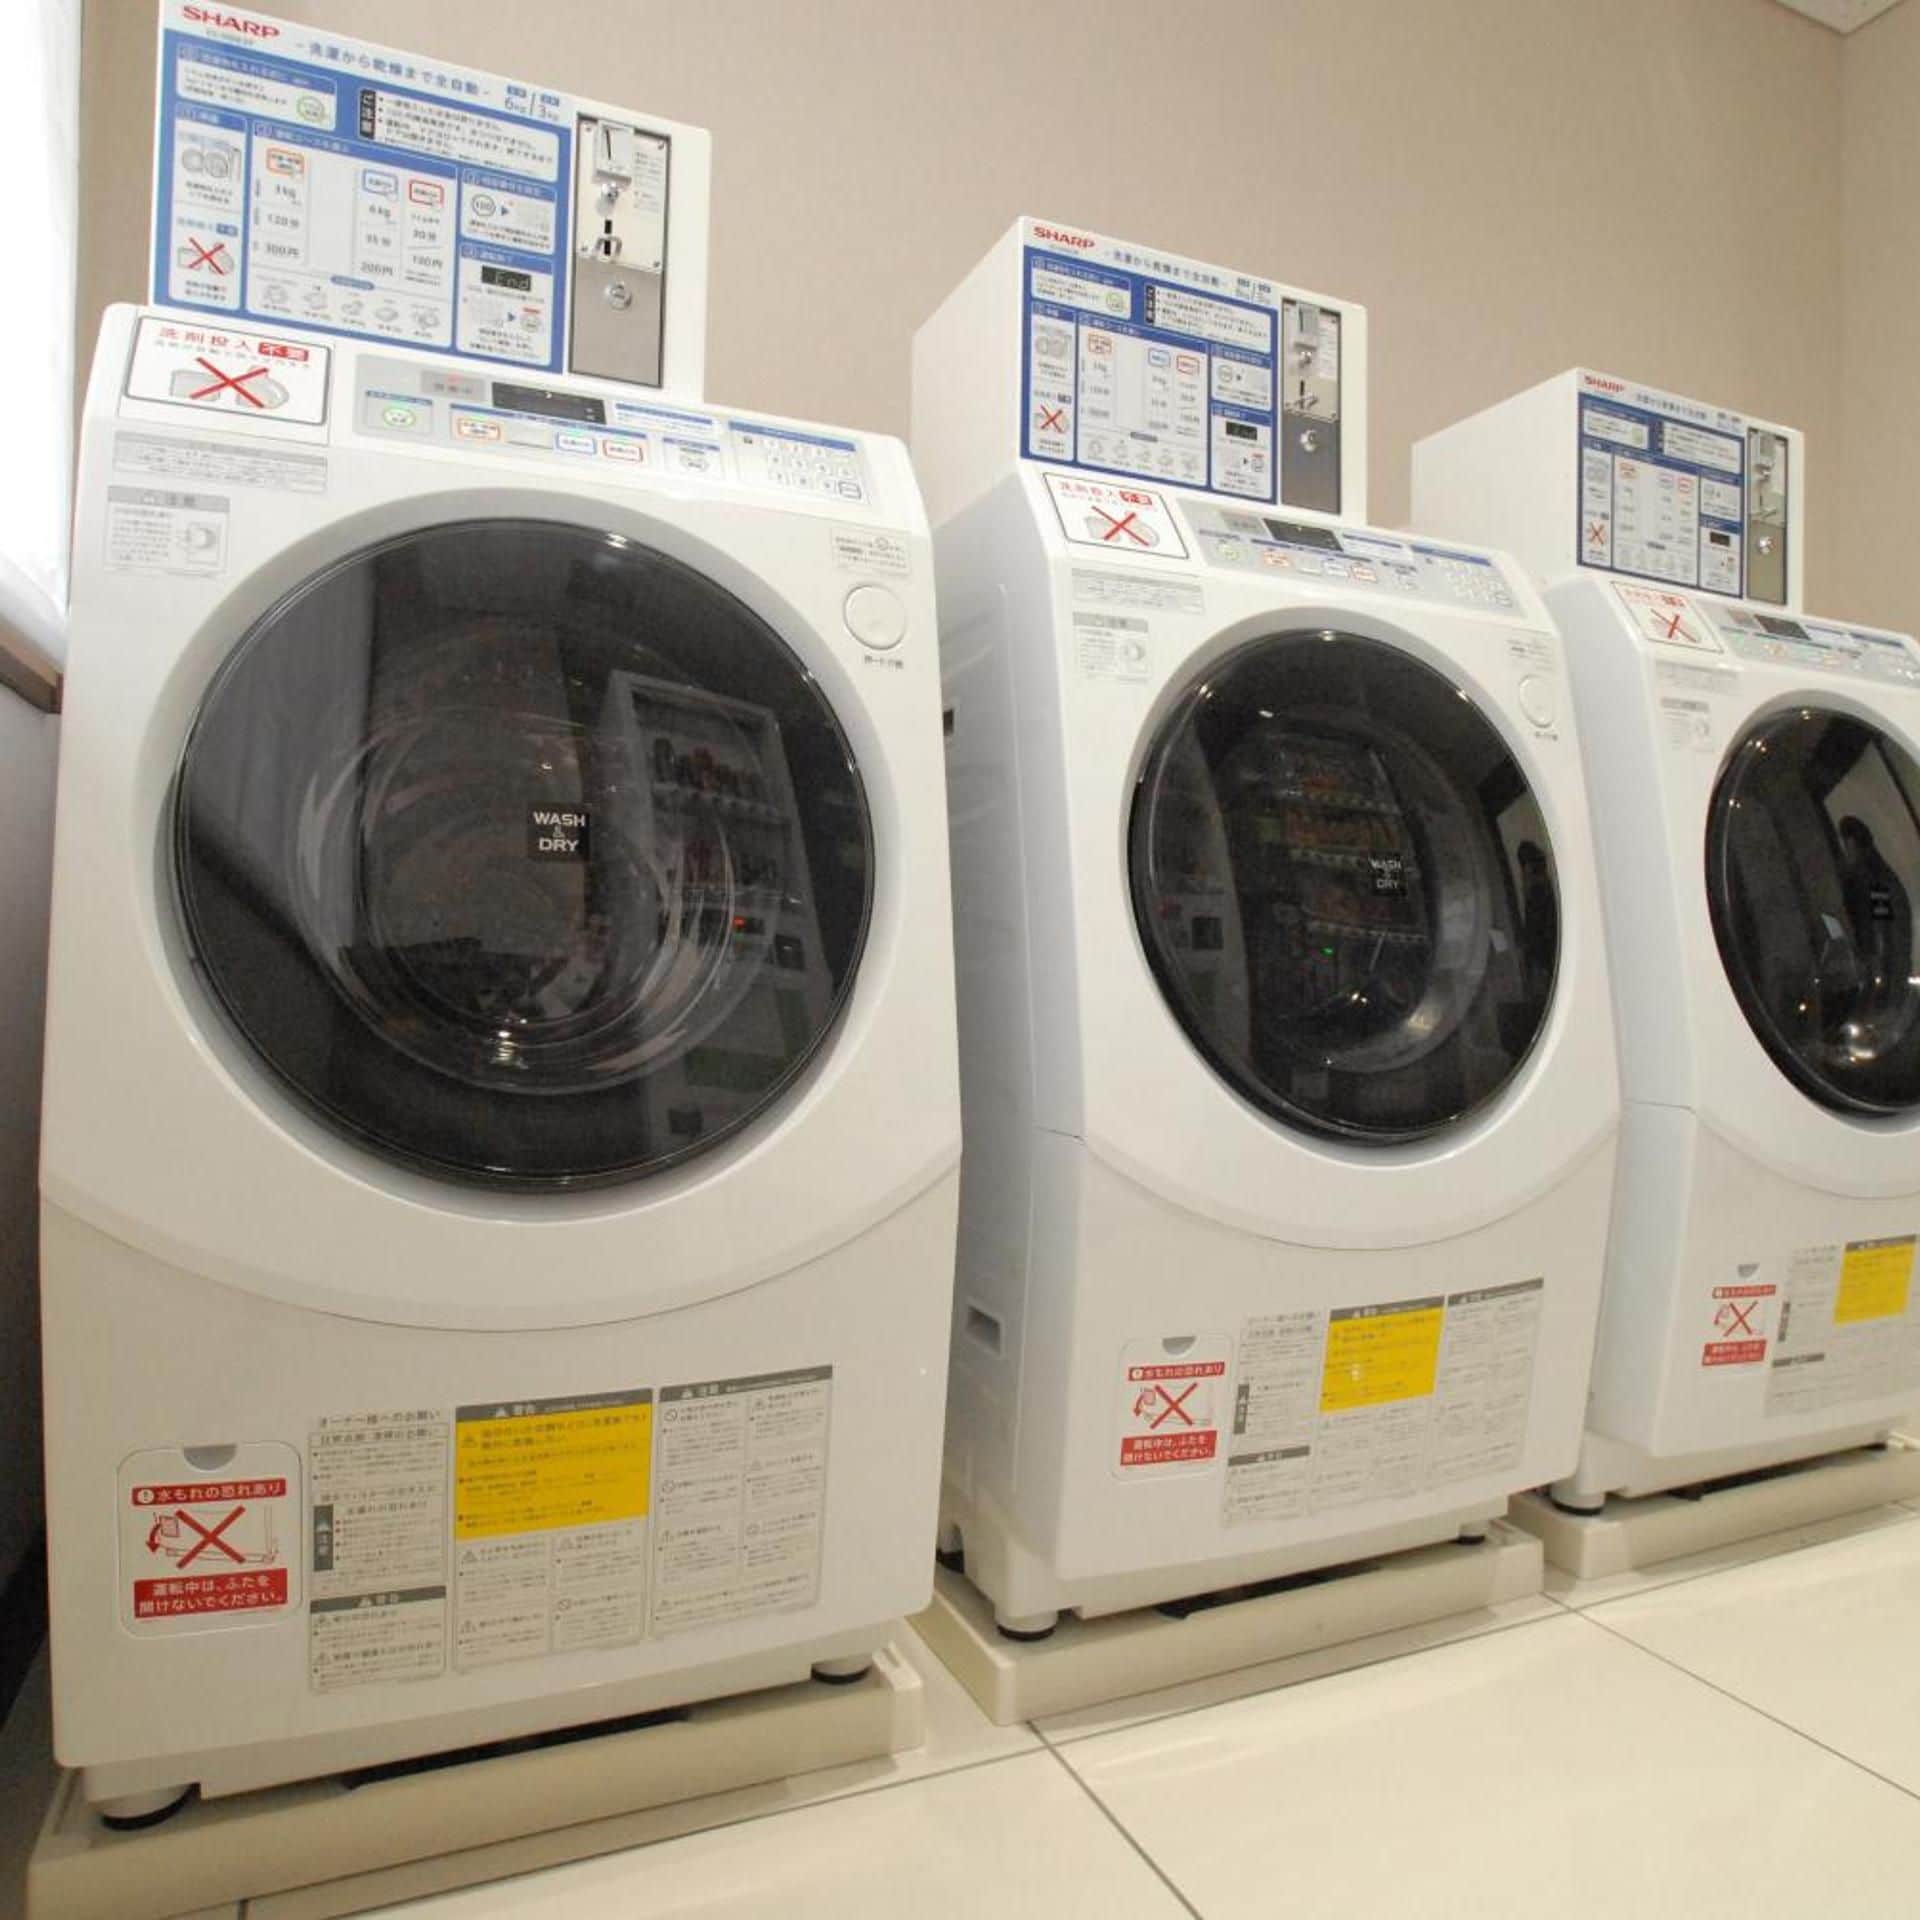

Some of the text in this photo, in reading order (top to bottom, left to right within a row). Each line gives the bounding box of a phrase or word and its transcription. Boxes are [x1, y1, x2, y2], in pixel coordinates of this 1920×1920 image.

[183, 6, 281, 39] SHARP
[1033, 226, 1096, 249] SHARP
[533, 811, 586, 827] WASH
[539, 837, 578, 852] DRY
[157, 1481, 282, 1502] 水もれの恐れあり
[152, 1575, 271, 1597] 運転中は、ふたを
[138, 1591, 282, 1615] 開けないでください。
